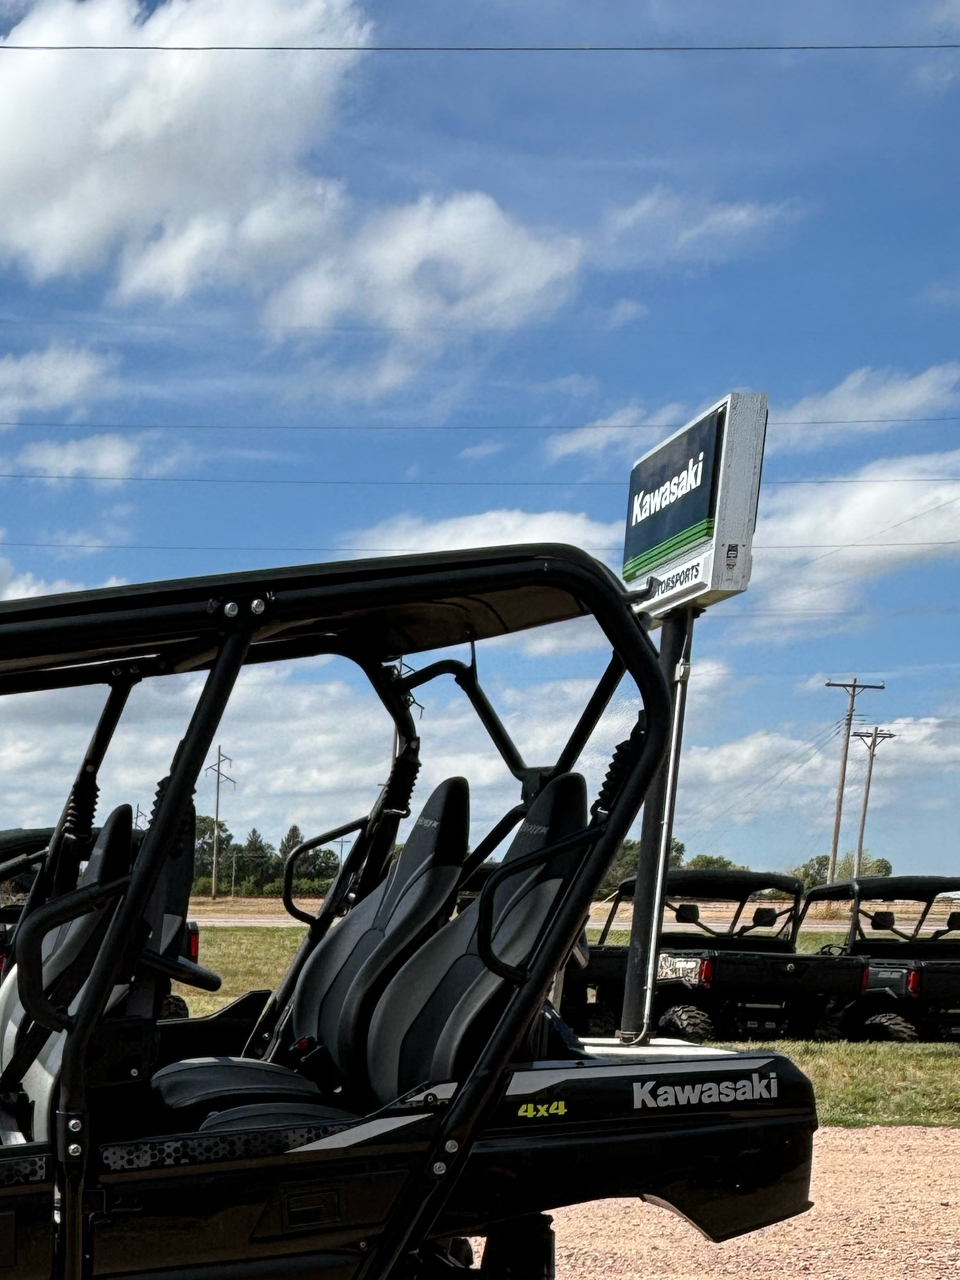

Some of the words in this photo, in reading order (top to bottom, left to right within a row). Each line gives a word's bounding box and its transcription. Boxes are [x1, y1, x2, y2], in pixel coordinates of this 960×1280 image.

[632, 451, 704, 527] Kawasaki
[632, 1072, 778, 1109] Kawasaki
[517, 1101, 568, 1119] 4x4
